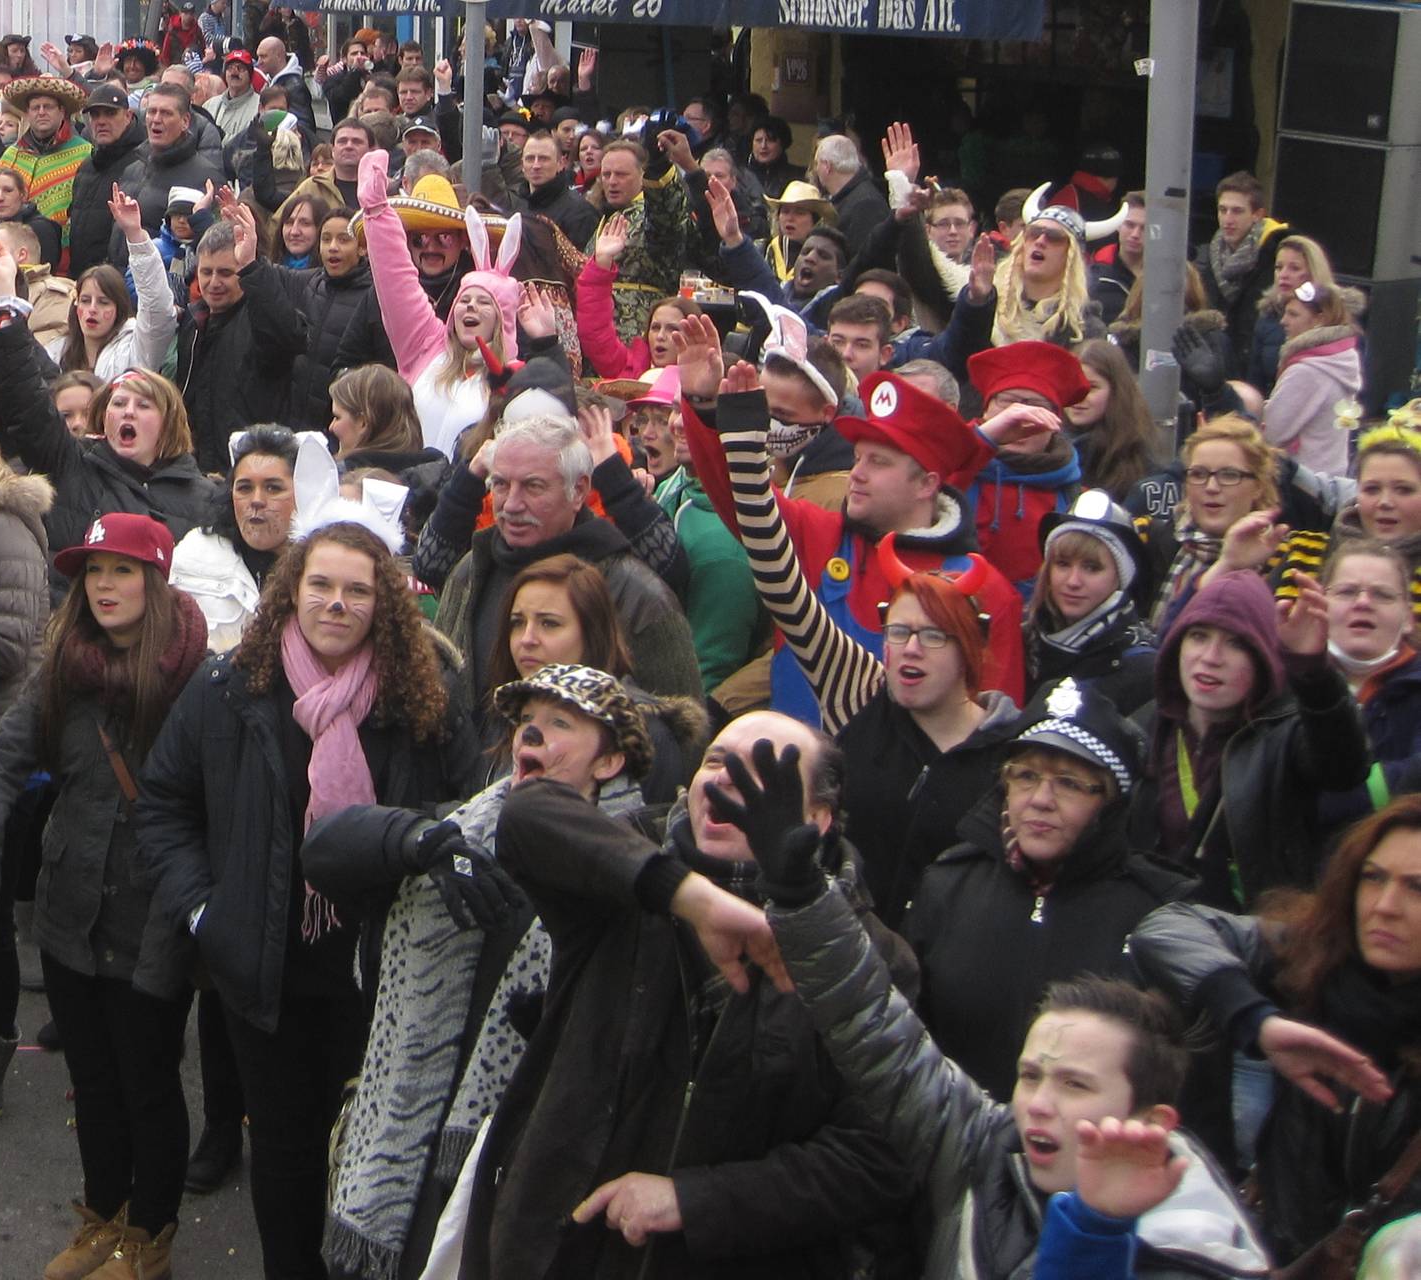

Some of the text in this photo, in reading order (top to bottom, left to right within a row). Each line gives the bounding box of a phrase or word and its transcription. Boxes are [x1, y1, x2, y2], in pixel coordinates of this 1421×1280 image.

[878, 0, 916, 30] Das
[921, 0, 961, 32] Alt.
[875, 390, 892, 407] M
